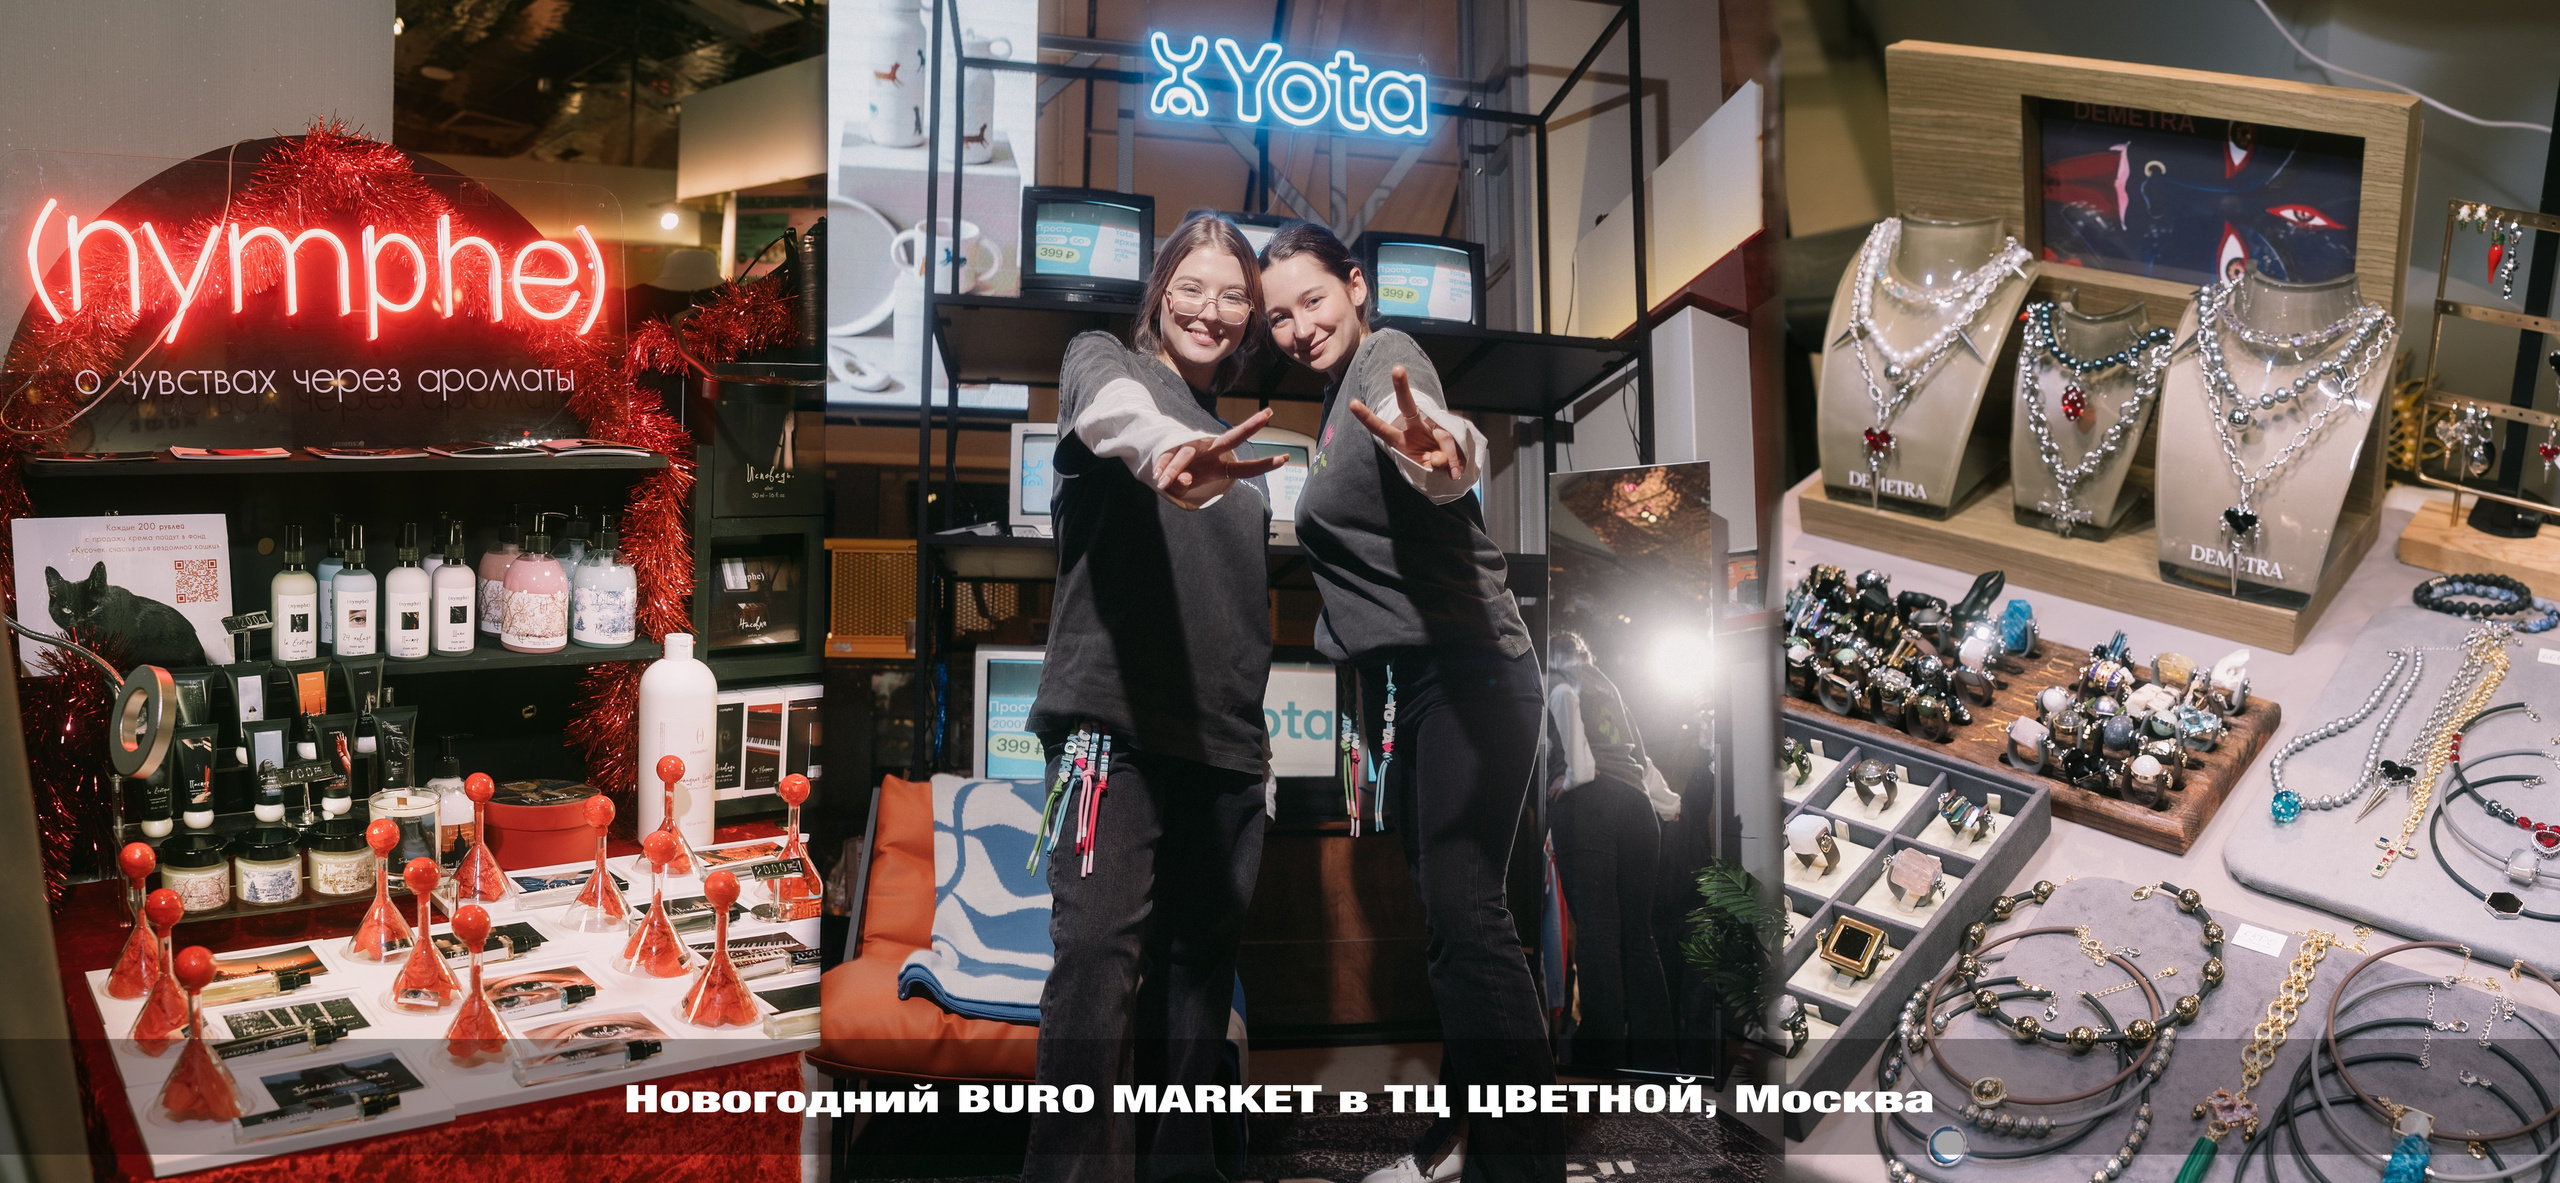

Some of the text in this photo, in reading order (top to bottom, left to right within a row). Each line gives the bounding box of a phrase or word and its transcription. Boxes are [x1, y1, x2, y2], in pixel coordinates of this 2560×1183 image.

[1214, 37, 1428, 136] Yota
[1036, 224, 1073, 234] Просто
[1040, 247, 1075, 259] 399 ₽
[28, 198, 605, 344] (nymphe)
[1378, 265, 1411, 274] Просто
[1382, 288, 1414, 299] 399 ₽
[75, 368, 576, 403] о чувствах через ароматы
[106, 522, 185, 532] Каждые 200 рублей
[92, 536, 126, 544] продажи
[128, 535, 153, 543] крема
[156, 534, 179, 542] пойдут
[71, 545, 106, 554] «Кусочек
[109, 545, 136, 553] счастья
[152, 542, 193, 551] бездомной
[233, 616, 260, 629] 1200
[988, 700, 1033, 715] Прост
[1263, 701, 1333, 740] ota
[996, 738, 1031, 754] 399
[754, 862, 787, 875] 2000
